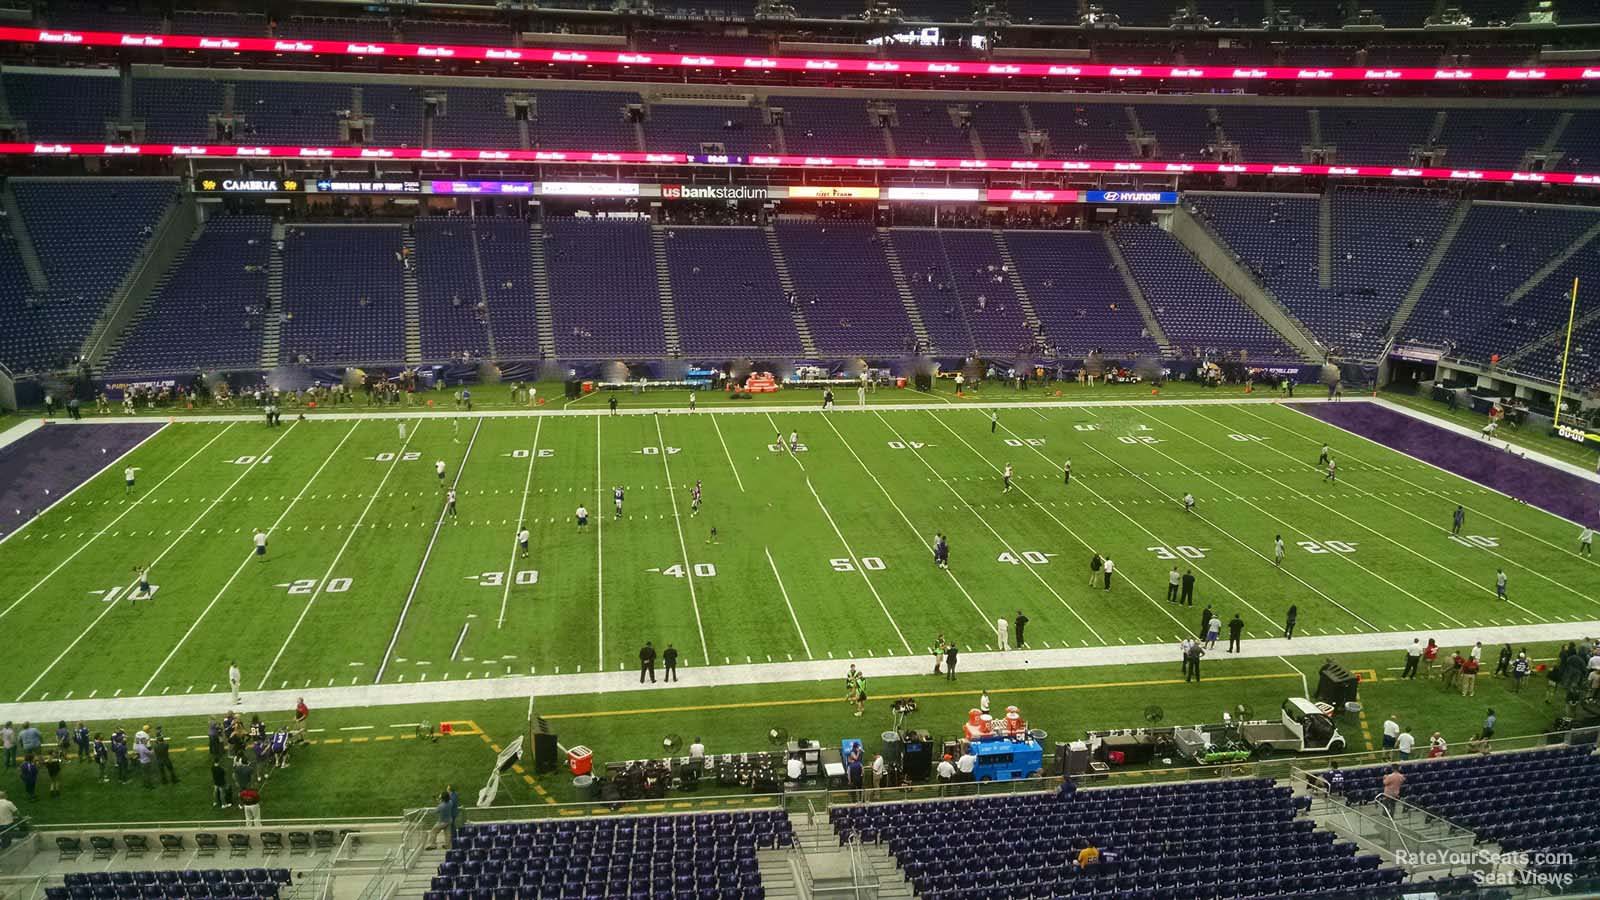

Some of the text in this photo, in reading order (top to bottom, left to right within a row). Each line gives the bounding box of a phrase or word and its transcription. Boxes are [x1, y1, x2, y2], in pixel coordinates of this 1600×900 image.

[223, 180, 278, 191] CAMBRIA
[1120, 193, 1160, 201] HYUNDAI
[375, 452, 421, 462] 20
[511, 449, 555, 458] 30
[641, 446, 682, 455] 40
[233, 455, 272, 465] 10
[1294, 540, 1356, 554] 20
[1447, 535, 1500, 548] 10
[996, 551, 1050, 565] 40
[1146, 546, 1205, 560] 30
[661, 563, 717, 579] 40
[828, 557, 887, 572] 50
[480, 570, 539, 586] 30
[287, 577, 355, 595] 20
[102, 585, 161, 602] 10
